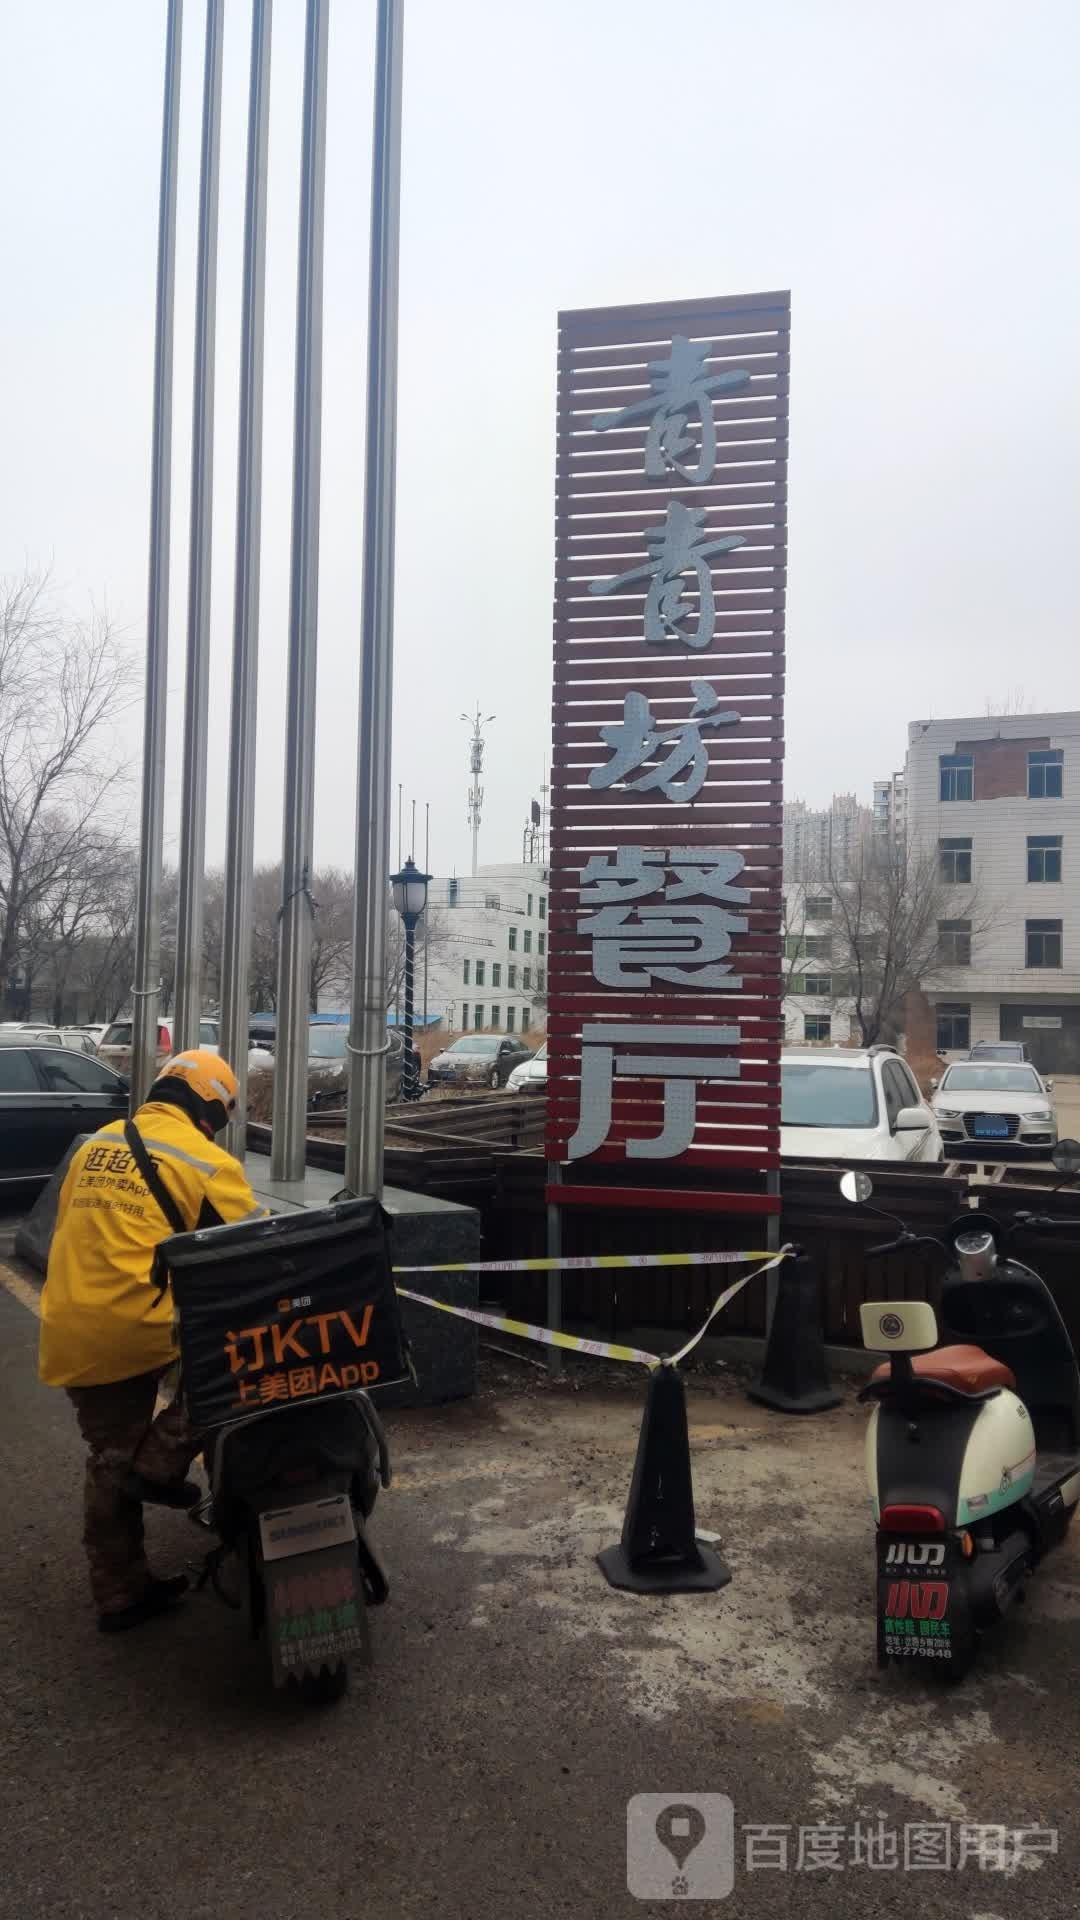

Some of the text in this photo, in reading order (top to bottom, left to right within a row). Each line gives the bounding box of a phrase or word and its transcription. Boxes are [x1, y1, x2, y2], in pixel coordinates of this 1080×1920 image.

[77, 1175, 150, 1197] 上美团外卖App
[224, 1304, 375, 1373] 订KTV
[232, 1360, 379, 1408] 上美团App
[885, 1647, 952, 1659] 62279848
